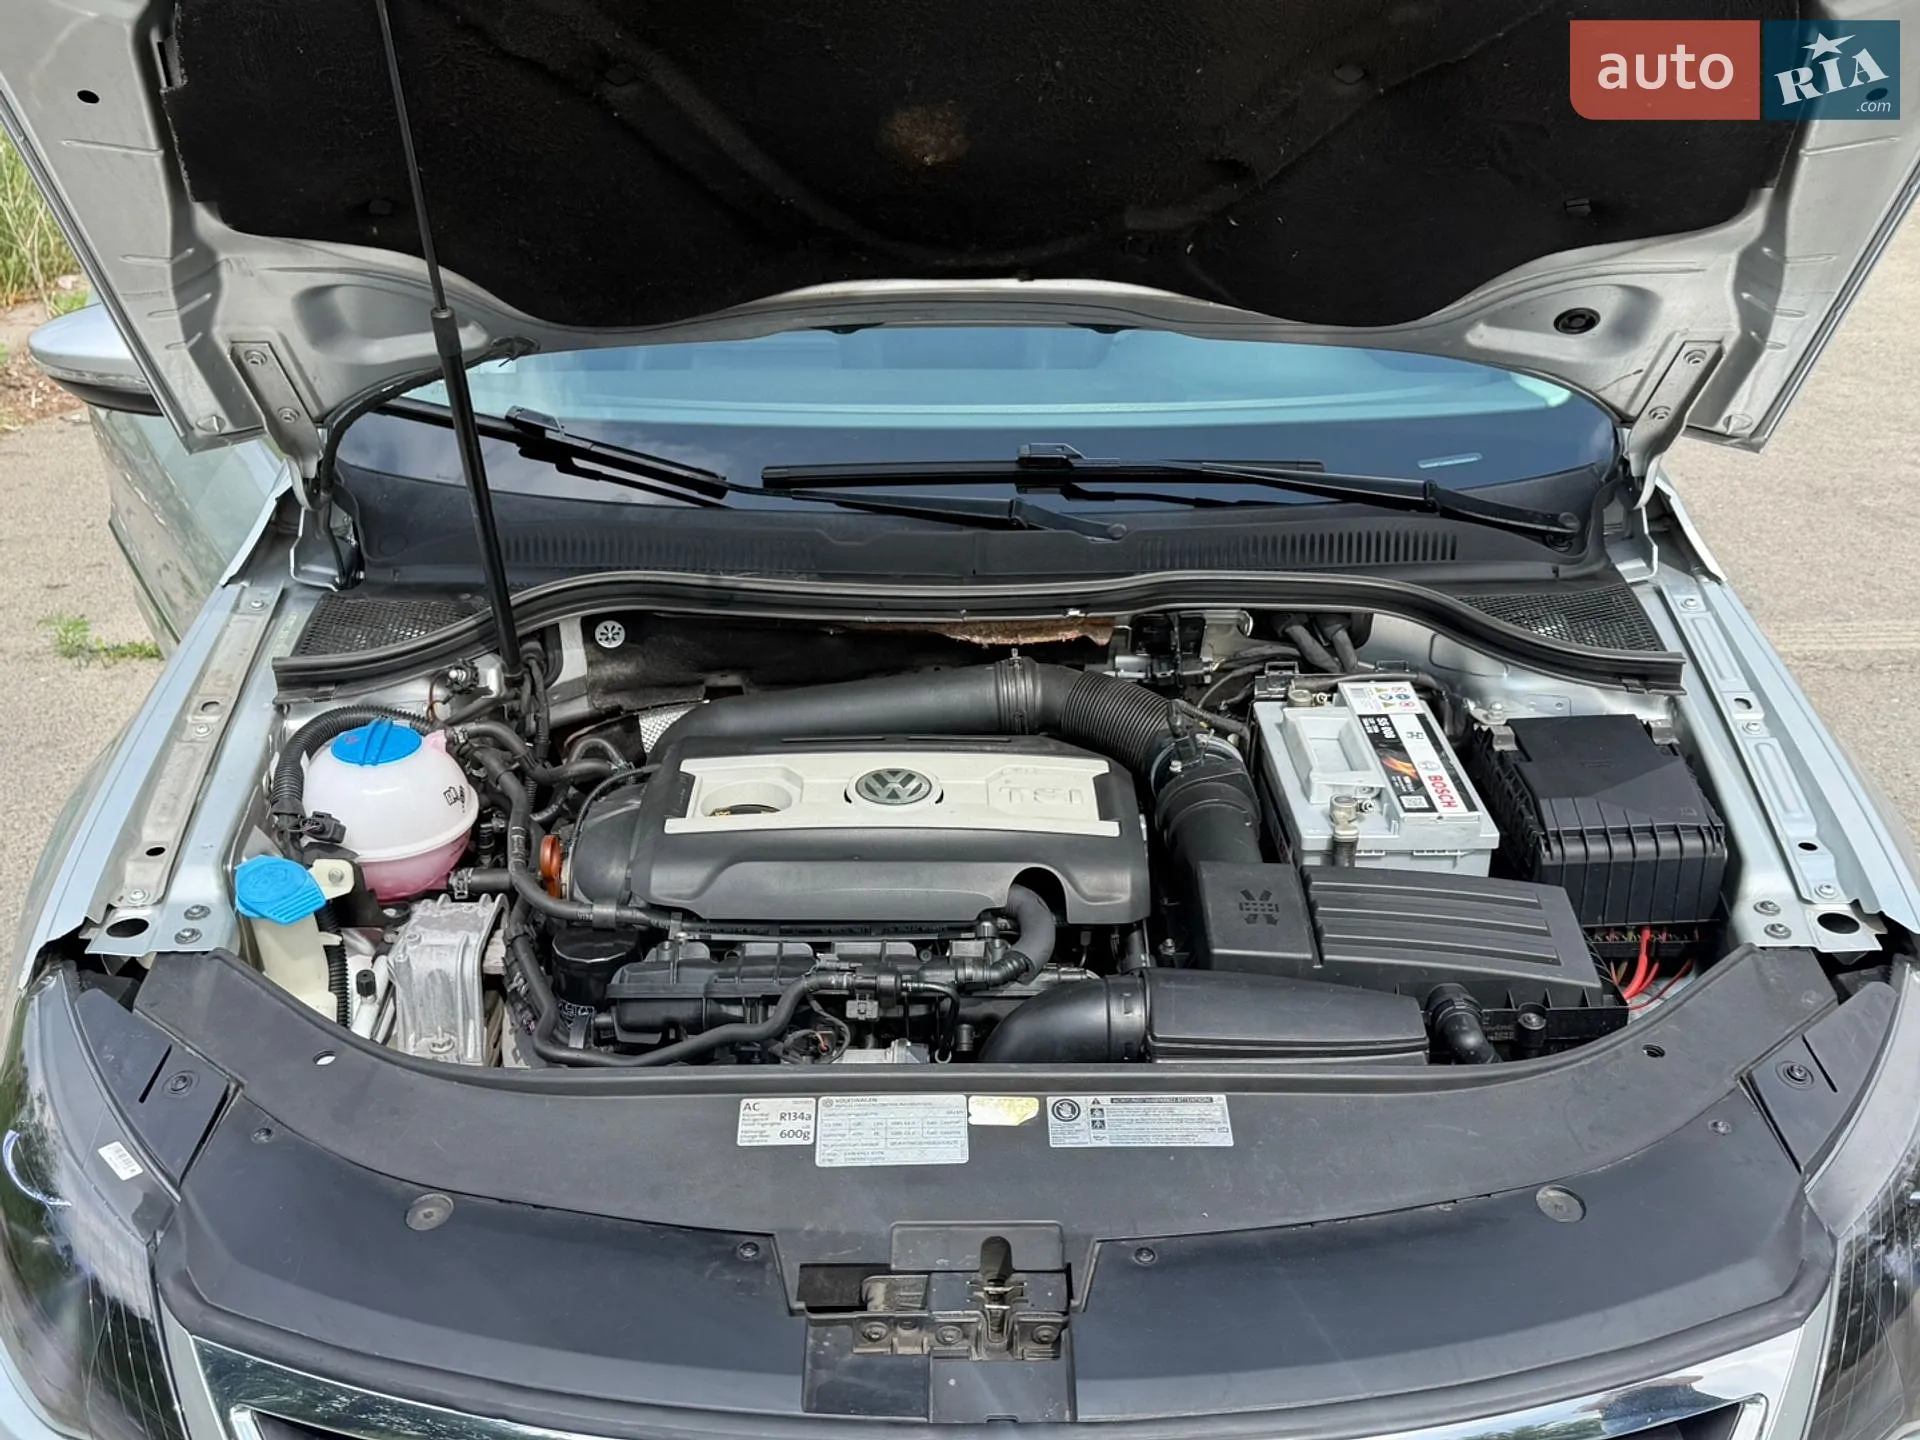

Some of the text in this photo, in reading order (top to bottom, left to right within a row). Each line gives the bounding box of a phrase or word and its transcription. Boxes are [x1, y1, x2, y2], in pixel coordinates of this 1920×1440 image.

[1428, 775, 1458, 809] BOSCH
[743, 1102, 761, 1112] AC
[779, 1112, 812, 1121] R134a
[779, 1129, 811, 1141] 600g
